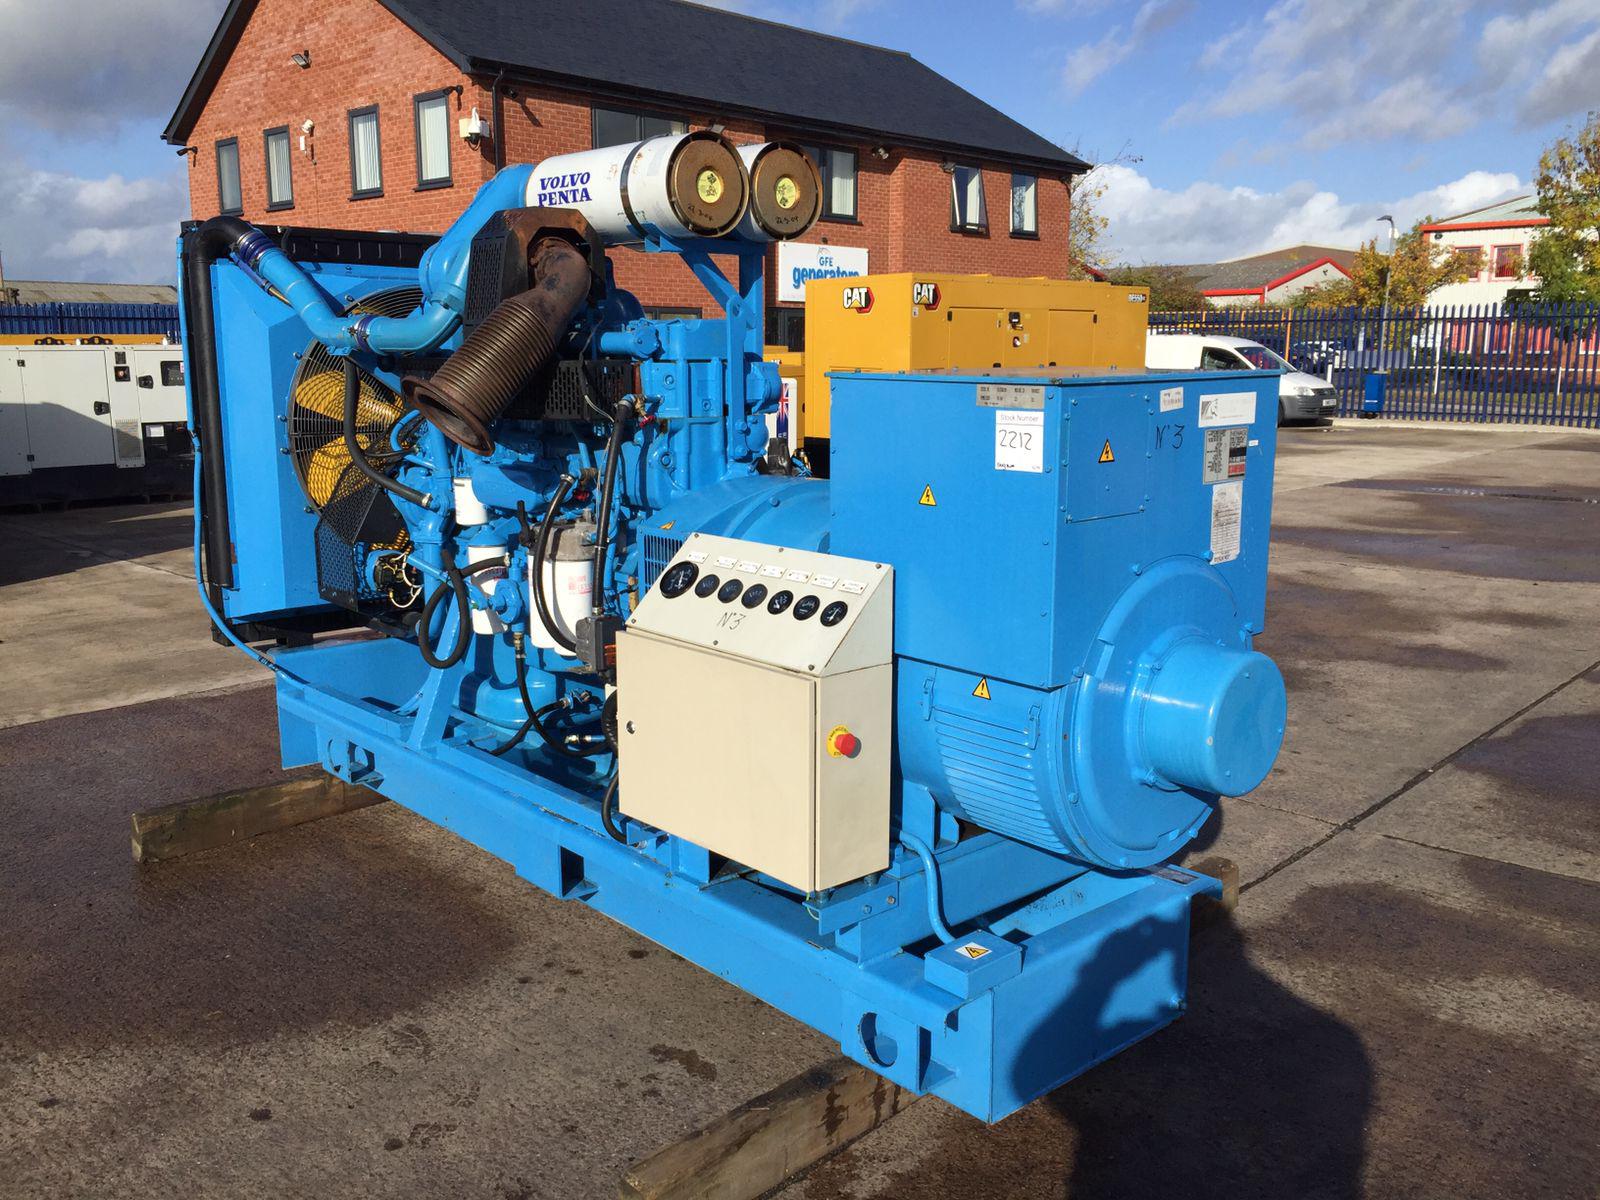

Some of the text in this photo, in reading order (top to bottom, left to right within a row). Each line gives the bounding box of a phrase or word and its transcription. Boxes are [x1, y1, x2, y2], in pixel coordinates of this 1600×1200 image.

[540, 171, 591, 190] VOLVO
[537, 187, 592, 208] PENTA
[819, 256, 834, 267] GFE
[842, 287, 868, 309] CAT
[912, 283, 935, 305] CAT
[998, 429, 1032, 451] 2212
